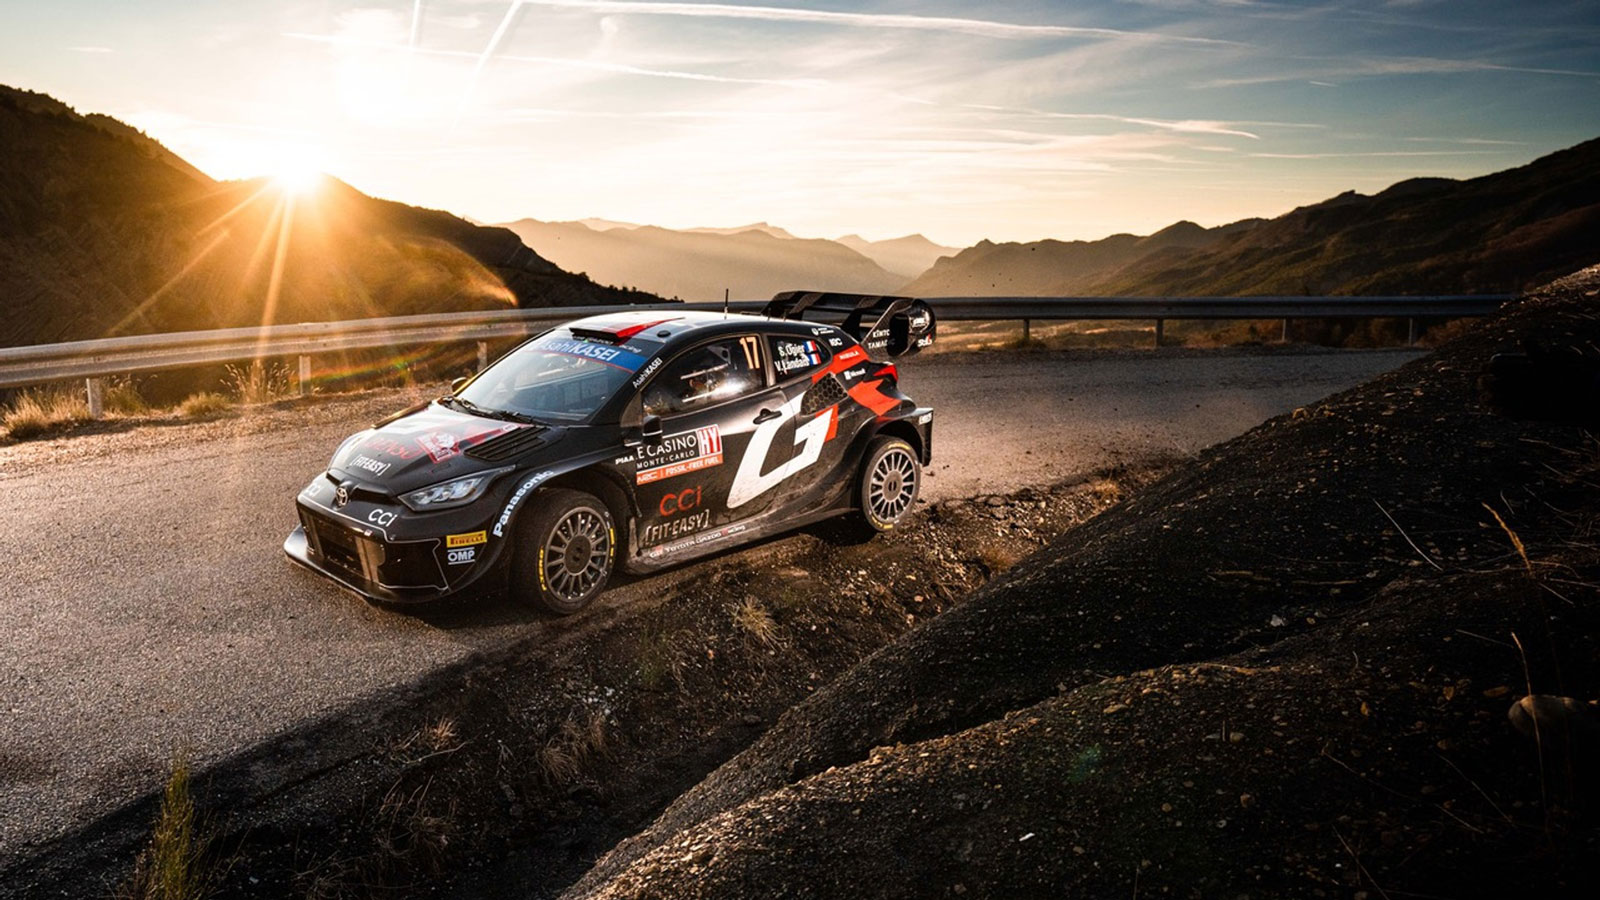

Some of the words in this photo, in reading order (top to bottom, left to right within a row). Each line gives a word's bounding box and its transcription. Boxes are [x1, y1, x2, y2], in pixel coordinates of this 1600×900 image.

[739, 336, 760, 370] 17
[646, 434, 697, 457] CASINO
[698, 427, 720, 456] HY
[615, 455, 634, 465] PIAA
[492, 470, 554, 537] Panasonic
[450, 533, 484, 545] PIRELLI
[447, 550, 475, 562] OMP
